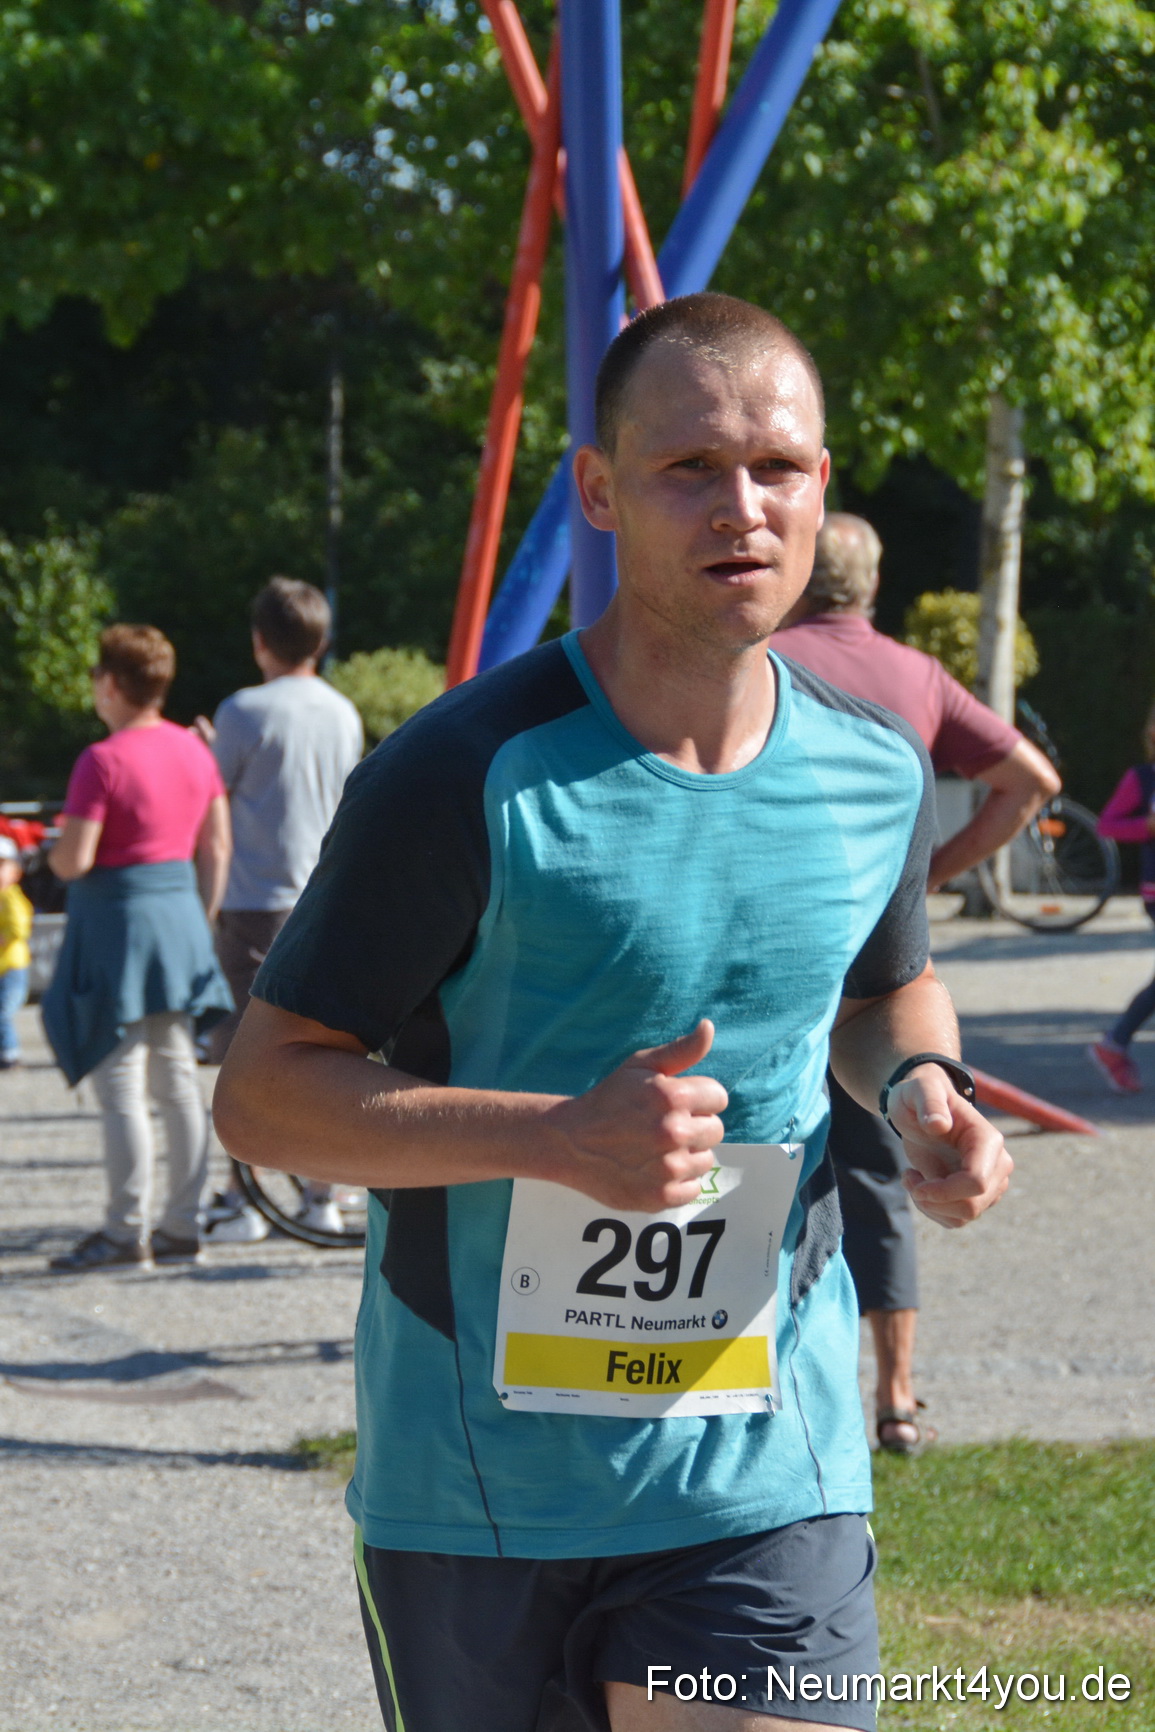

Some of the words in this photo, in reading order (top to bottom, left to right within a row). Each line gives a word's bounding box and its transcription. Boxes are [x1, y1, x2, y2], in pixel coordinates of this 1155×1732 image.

[575, 1218, 726, 1302] 297
[519, 1274, 530, 1288] B
[564, 1309, 626, 1329] PARTL
[631, 1314, 706, 1331] Neumarkt
[606, 1350, 683, 1385] Felix
